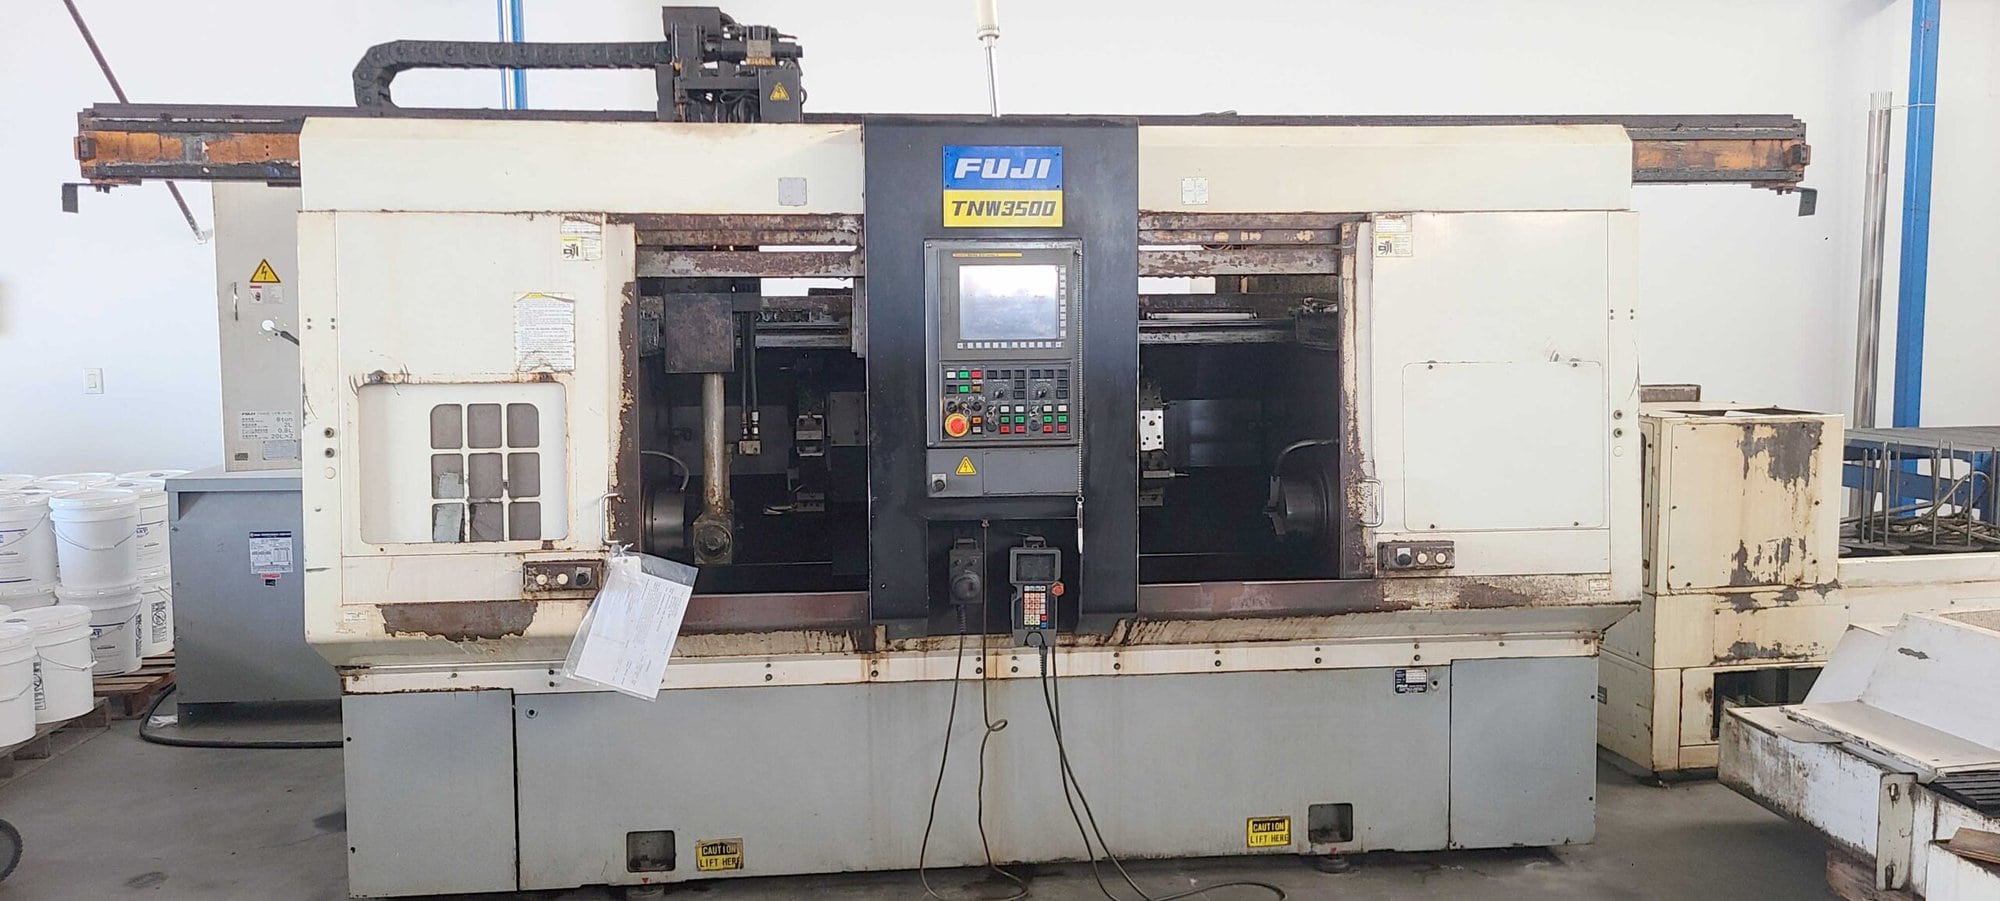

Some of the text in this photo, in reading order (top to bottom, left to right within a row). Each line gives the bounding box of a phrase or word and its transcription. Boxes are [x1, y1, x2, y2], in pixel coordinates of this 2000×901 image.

[954, 158, 1051, 179] FUJI
[952, 200, 1056, 217] TNW3500
[1253, 822, 1284, 832] CAUTION
[1250, 834, 1290, 844] LIFT HERE
[702, 845, 736, 855] CAUTION
[699, 858, 718, 868] LIFT
